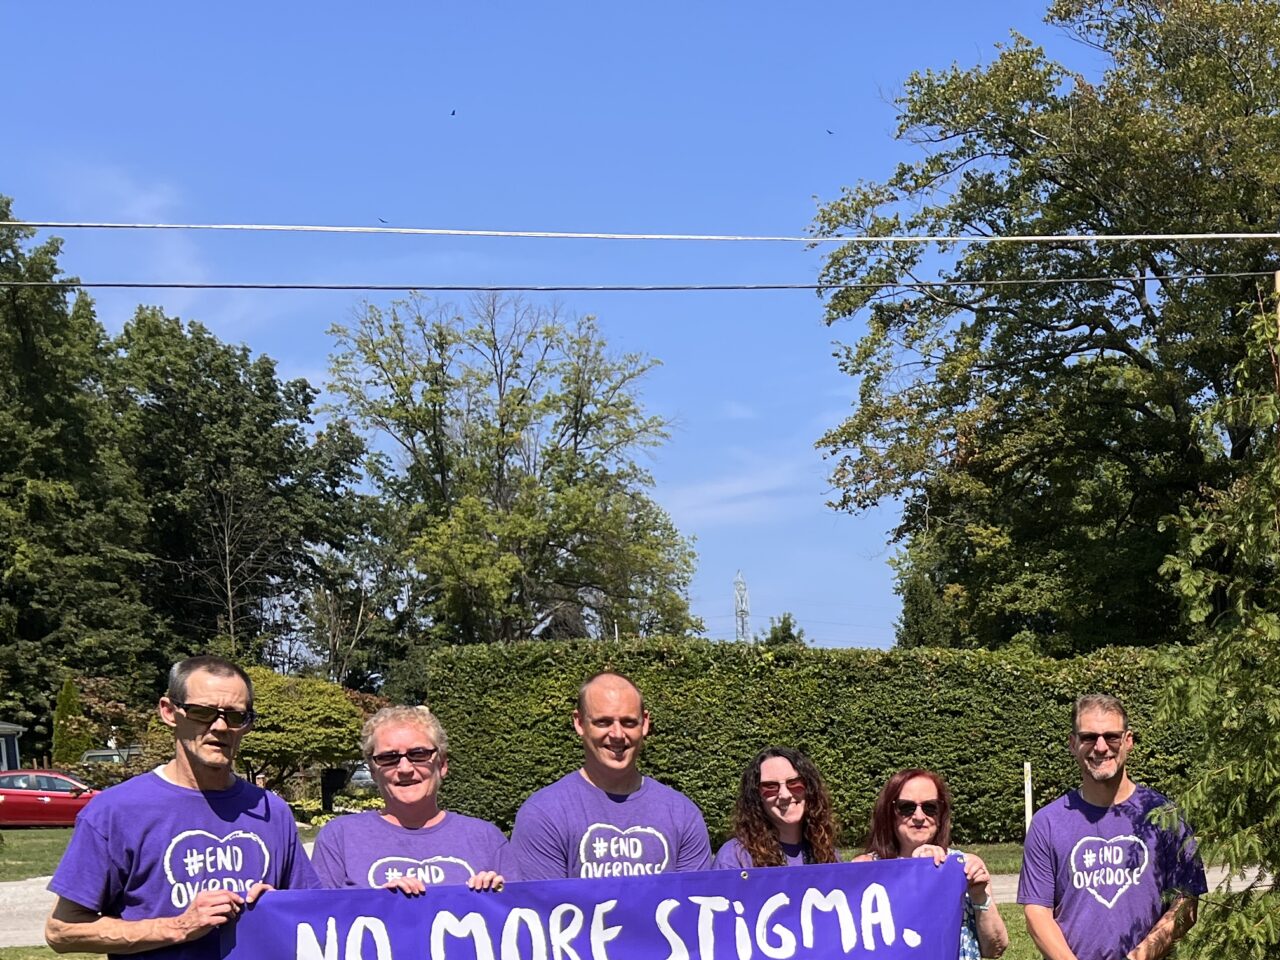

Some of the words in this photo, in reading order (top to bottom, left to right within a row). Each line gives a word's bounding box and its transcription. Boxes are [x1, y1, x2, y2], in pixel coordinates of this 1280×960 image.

[592, 836, 643, 859] #END
[1083, 845, 1124, 868] #END
[183, 845, 243, 877] #END
[1073, 866, 1141, 889] OVERDOSE
